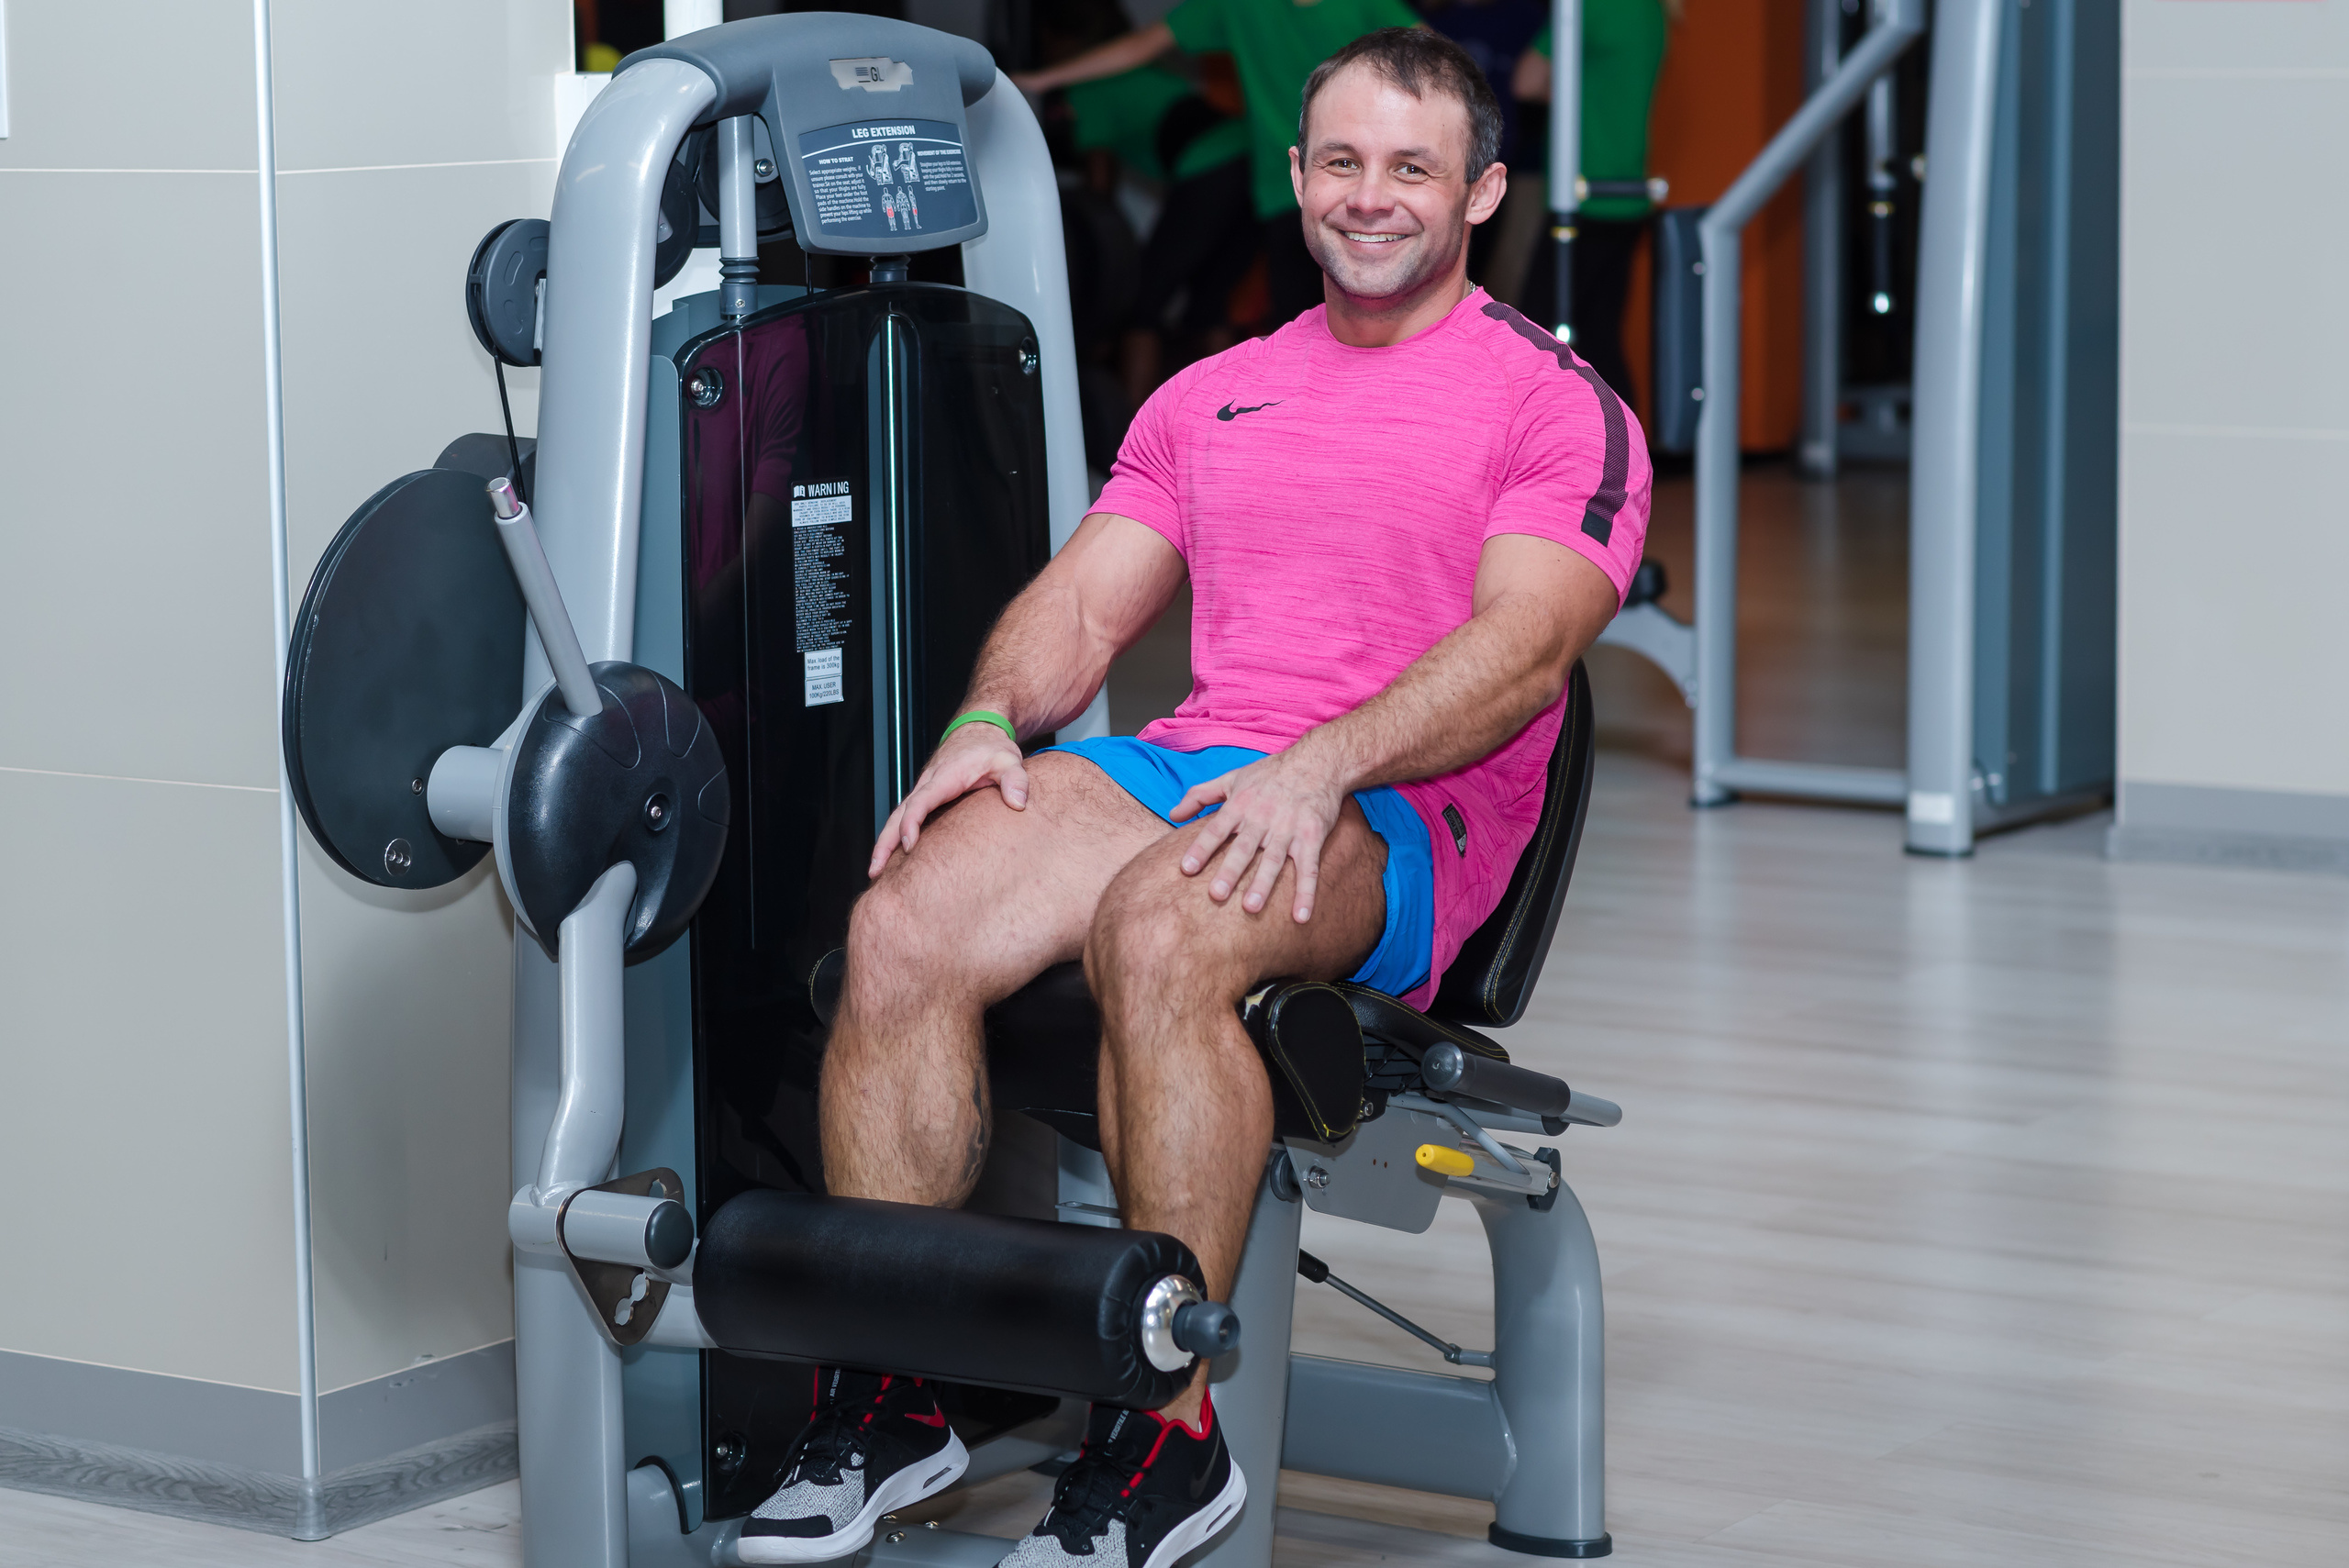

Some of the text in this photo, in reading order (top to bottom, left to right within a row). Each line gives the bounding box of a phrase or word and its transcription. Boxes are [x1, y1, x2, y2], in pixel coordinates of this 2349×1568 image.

[852, 126, 916, 139] LEG EXTENSION
[807, 481, 849, 497] WARNING
[809, 689, 840, 699] 100Kg/220LBS
